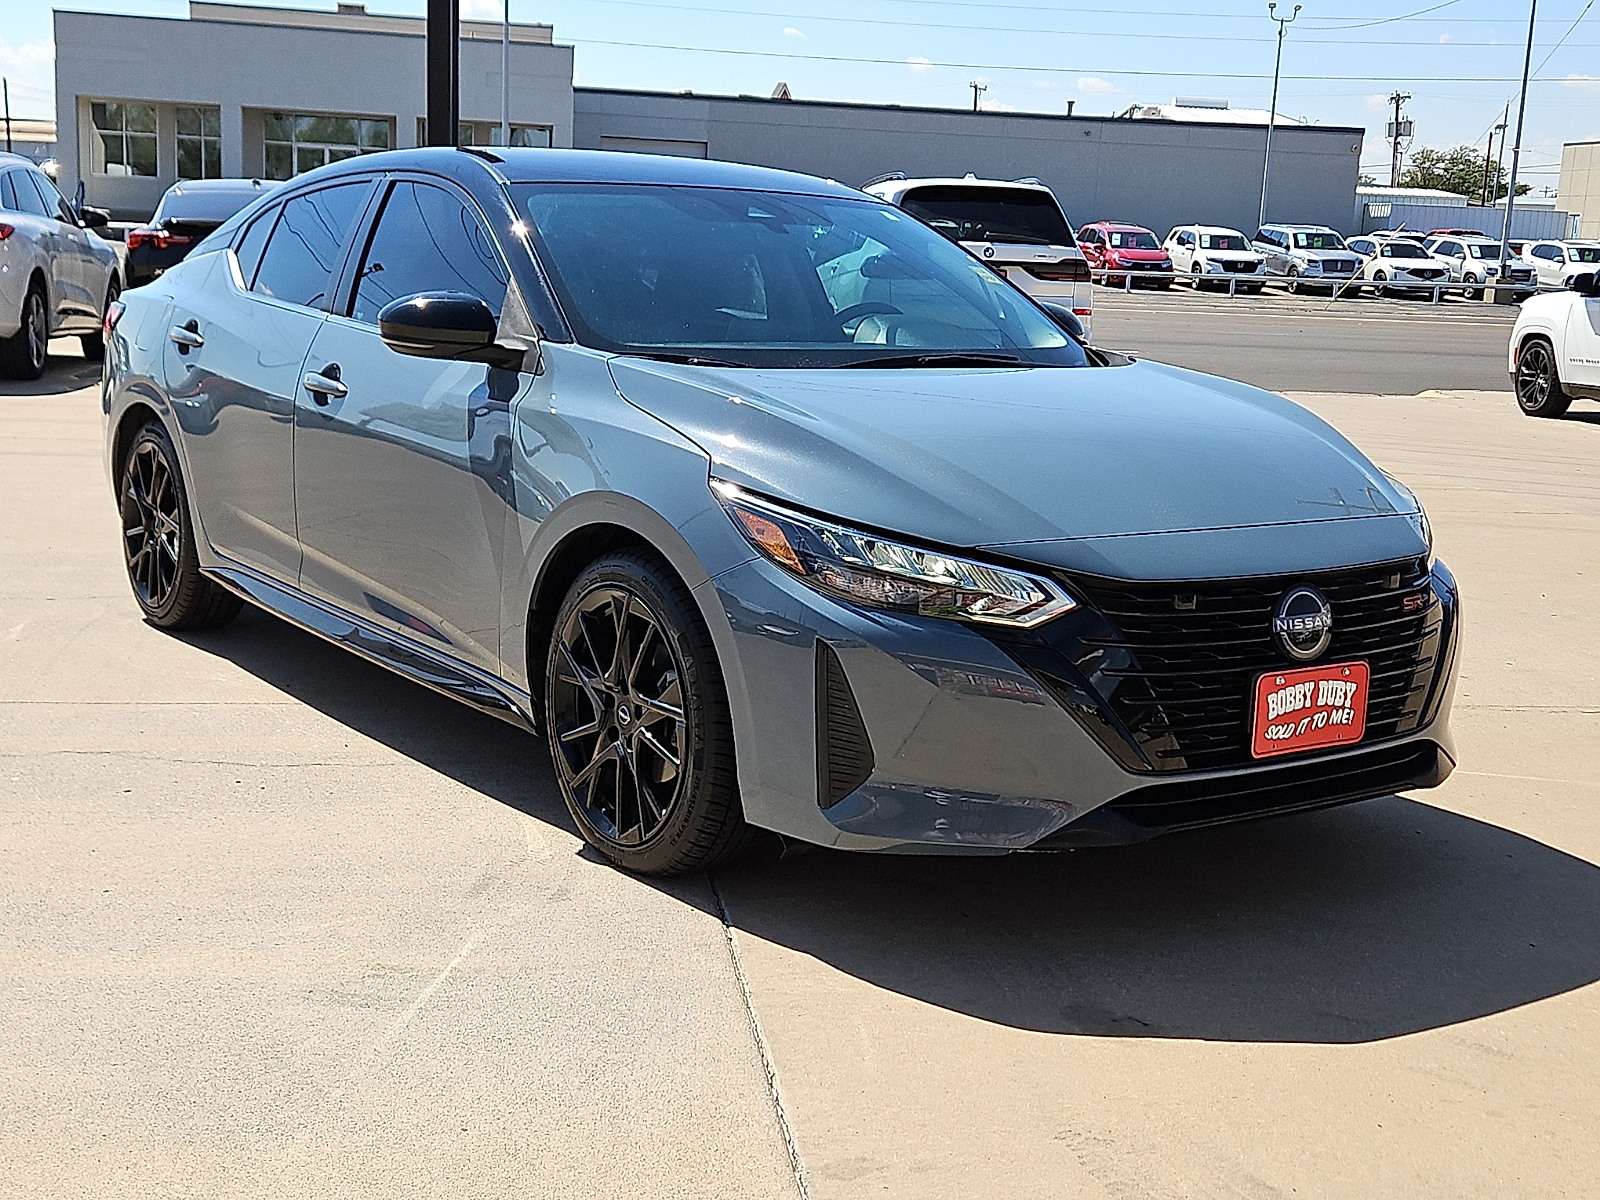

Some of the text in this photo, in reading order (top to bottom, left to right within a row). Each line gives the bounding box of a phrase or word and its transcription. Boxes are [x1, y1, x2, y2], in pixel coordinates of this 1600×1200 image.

[1402, 594, 1422, 611] SR
[1276, 614, 1332, 631] NISSAN
[1267, 680, 1358, 720] BOBBY DUBY
[1265, 708, 1354, 739] SOLD IT TO ME!
